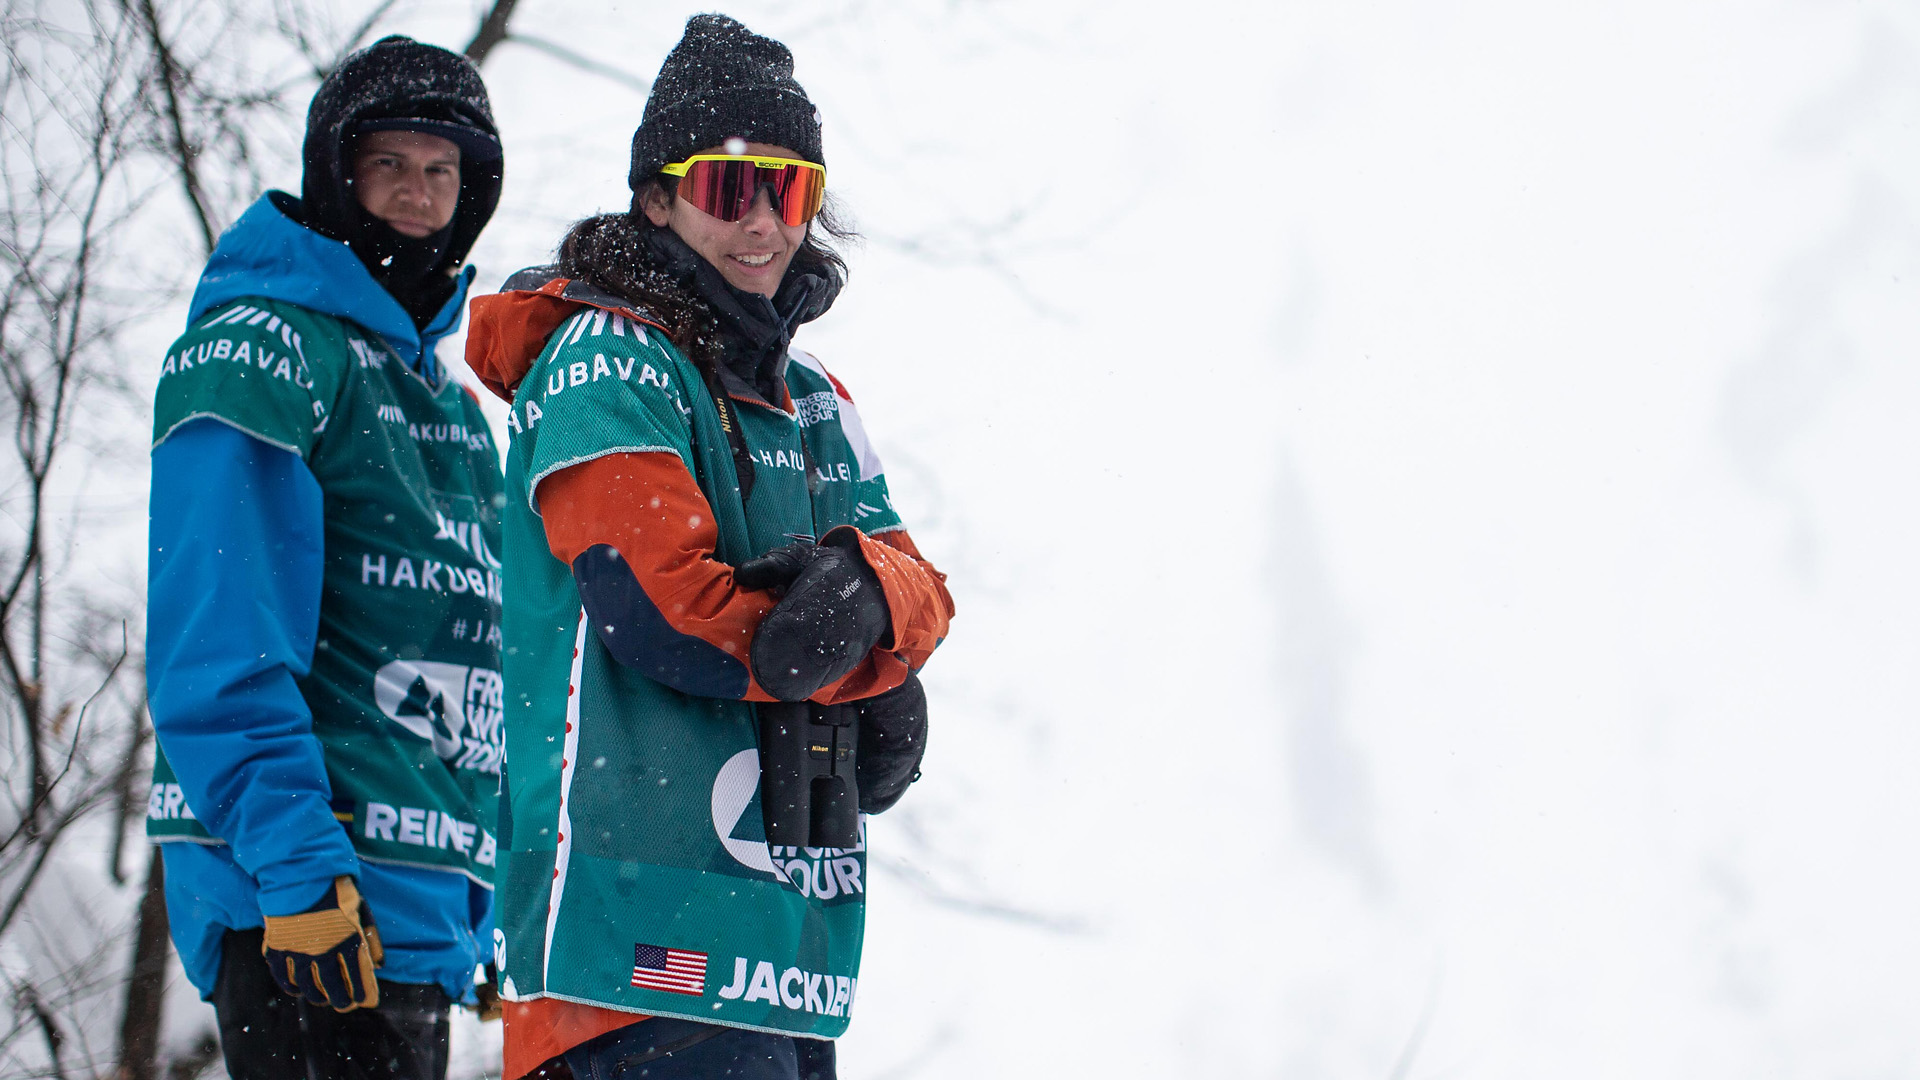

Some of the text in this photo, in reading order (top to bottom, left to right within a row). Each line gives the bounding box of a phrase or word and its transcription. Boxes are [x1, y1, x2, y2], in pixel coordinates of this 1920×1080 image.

[717, 397, 732, 433] Nikon
[800, 400, 838, 418] WORLD
[803, 410, 835, 427] TOUR
[364, 801, 478, 857] REINE
